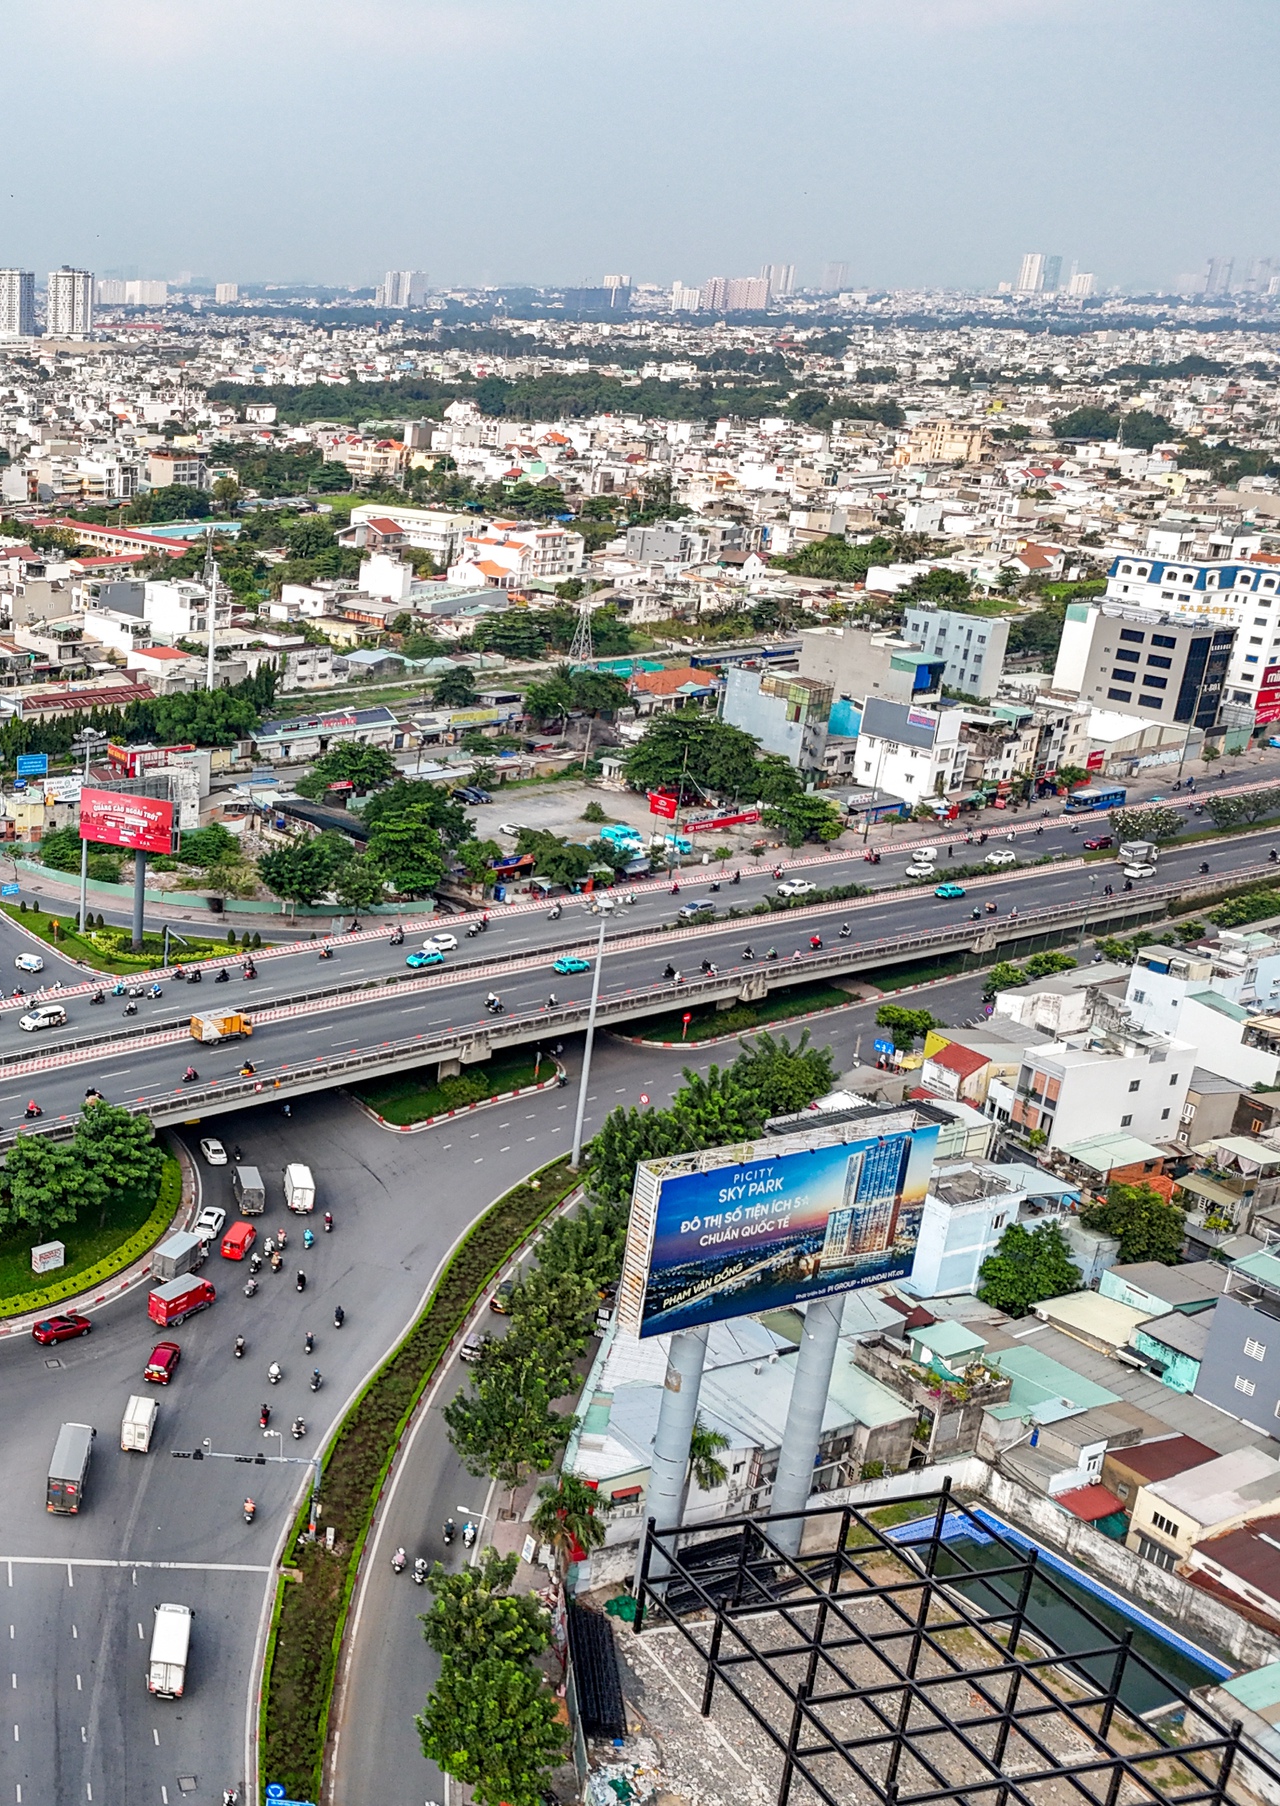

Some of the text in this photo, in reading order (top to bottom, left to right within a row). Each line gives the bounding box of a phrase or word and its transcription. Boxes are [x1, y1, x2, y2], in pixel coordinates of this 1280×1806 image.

[718, 1177, 784, 1203] SKY PARK
[734, 1167, 774, 1184] PICITY
[680, 1216, 701, 1233] ĐÔ
[703, 1213, 722, 1228] THỊ
[724, 1205, 743, 1224] SỐ
[744, 1203, 769, 1220] TIỆN
[771, 1198, 792, 1214] ÍCH
[699, 1213, 791, 1246] CHUẨN QUỐC TẾ
[662, 1263, 744, 1309] PHẠM VĂN ĐỒNG
[827, 1285, 834, 1293] PI
[834, 1279, 857, 1291] GROUP
[860, 1273, 887, 1285] HYUNDAI
